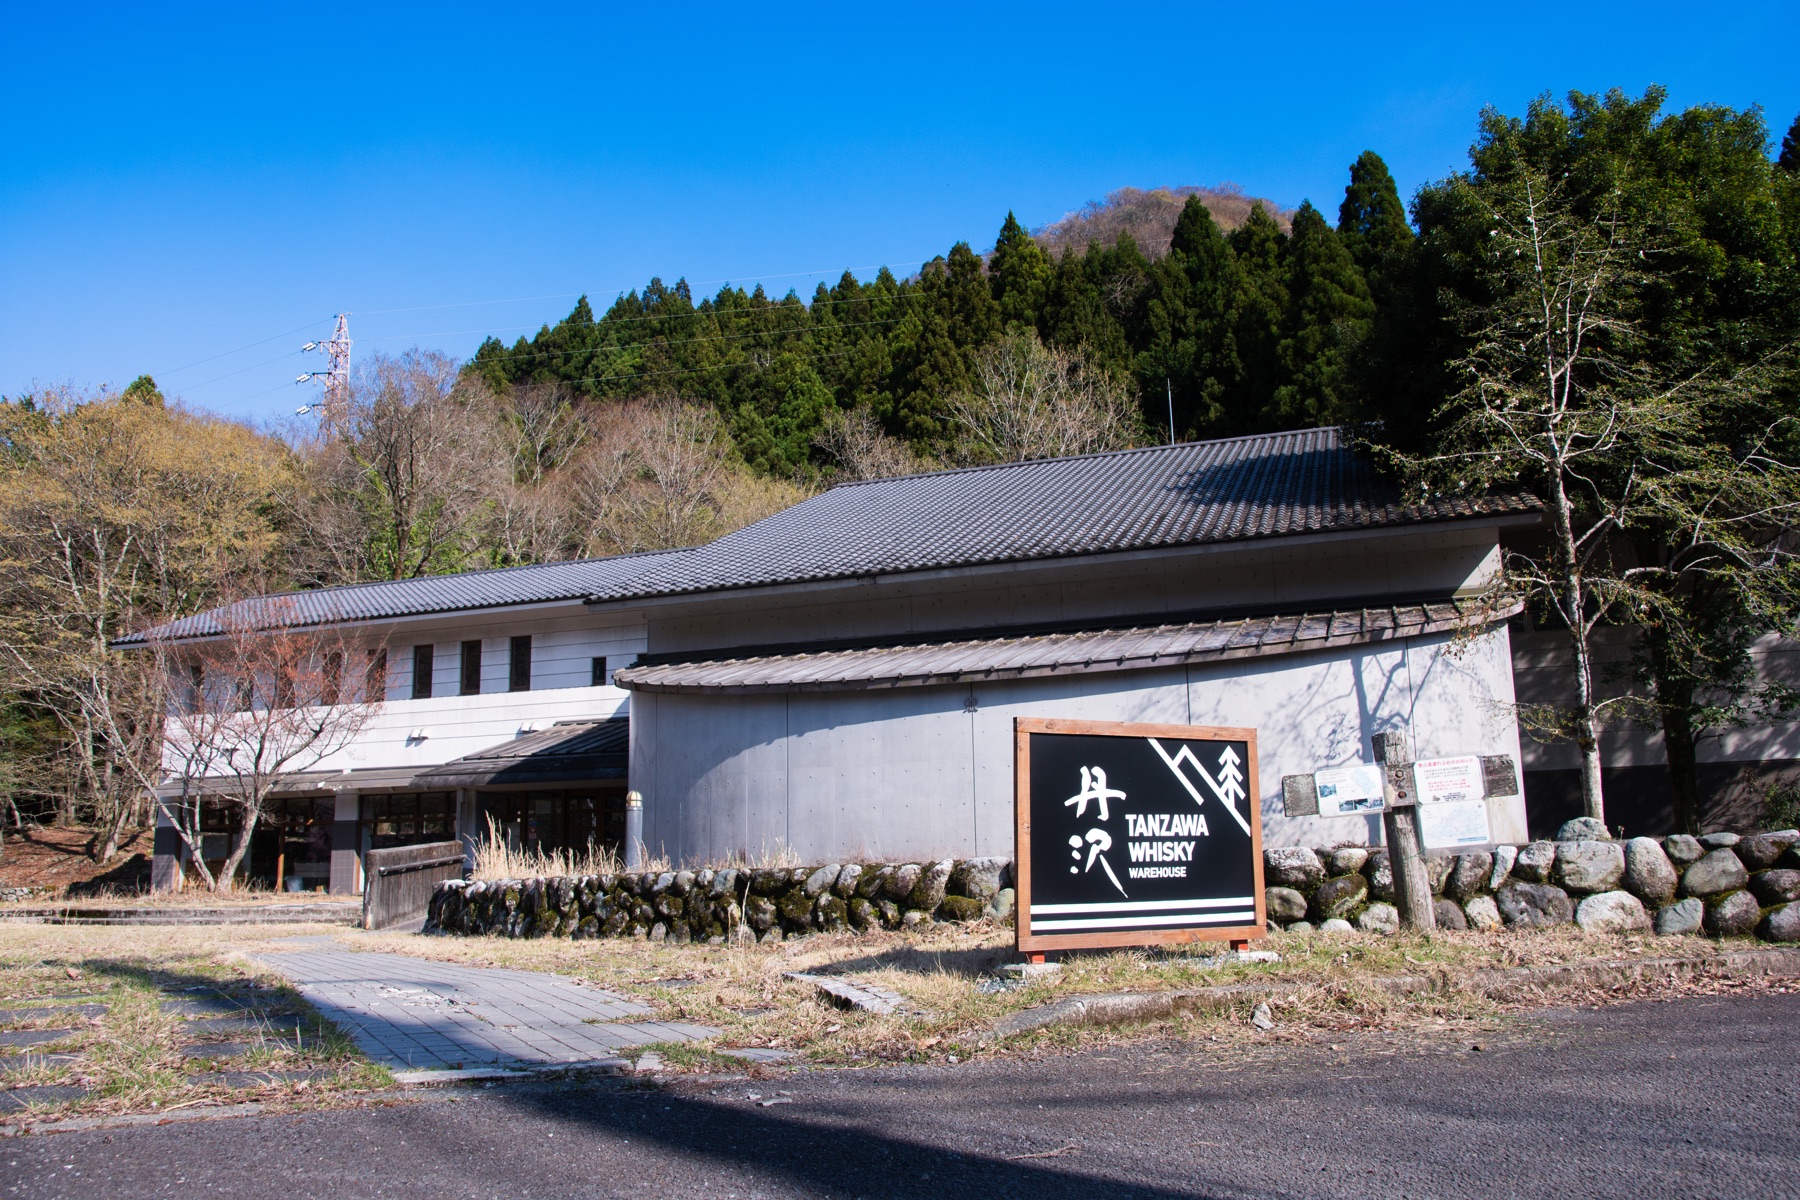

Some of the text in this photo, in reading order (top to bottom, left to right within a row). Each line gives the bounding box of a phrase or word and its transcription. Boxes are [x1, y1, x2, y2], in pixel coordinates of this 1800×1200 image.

[1064, 765, 1128, 898] 丹沢
[1125, 813, 1210, 837] TANZAWA
[1128, 840, 1196, 863] WHISKY
[1128, 866, 1187, 879] WAREHOUSE
